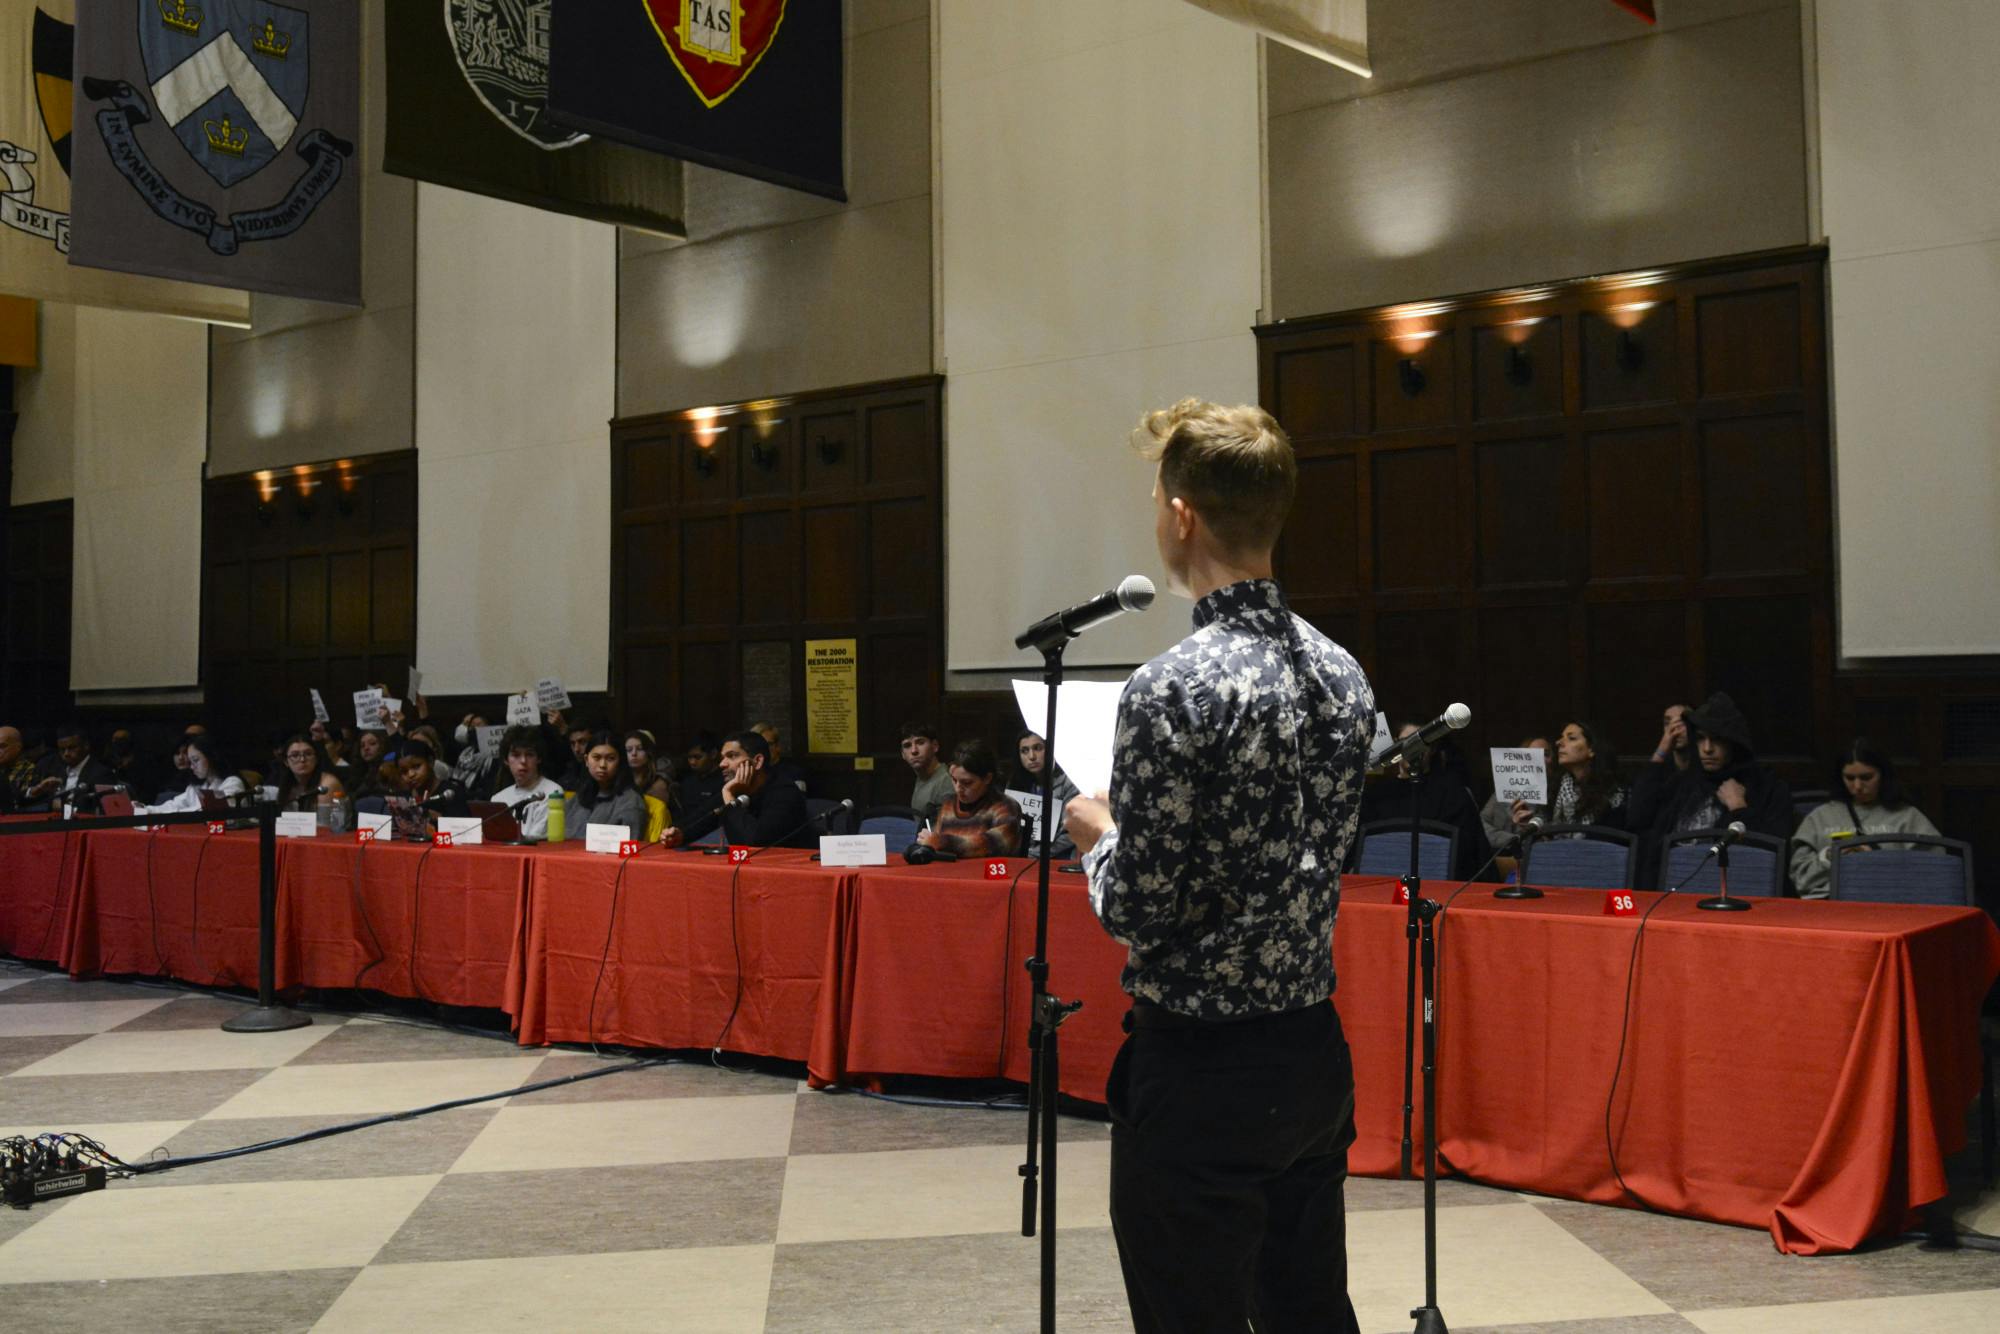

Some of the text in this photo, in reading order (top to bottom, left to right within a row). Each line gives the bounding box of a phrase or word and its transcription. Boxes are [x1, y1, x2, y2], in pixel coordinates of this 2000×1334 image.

[691, 1, 730, 33] TAS
[506, 99, 541, 132] 17
[16, 207, 49, 231] DEI
[815, 648, 847, 656] THE 2000
[808, 657, 854, 665] RESTORATION
[1495, 765, 1534, 773] COMPLICIT
[1503, 790, 1541, 800] GENOCIDE
[1022, 797, 1042, 808] LET
[623, 844, 637, 855] 31
[732, 850, 748, 861] 32
[989, 863, 1006, 876] 33
[1402, 886, 1410, 900] 3
[1614, 896, 1633, 910] 36
[38, 1178, 84, 1191] whirlwind
